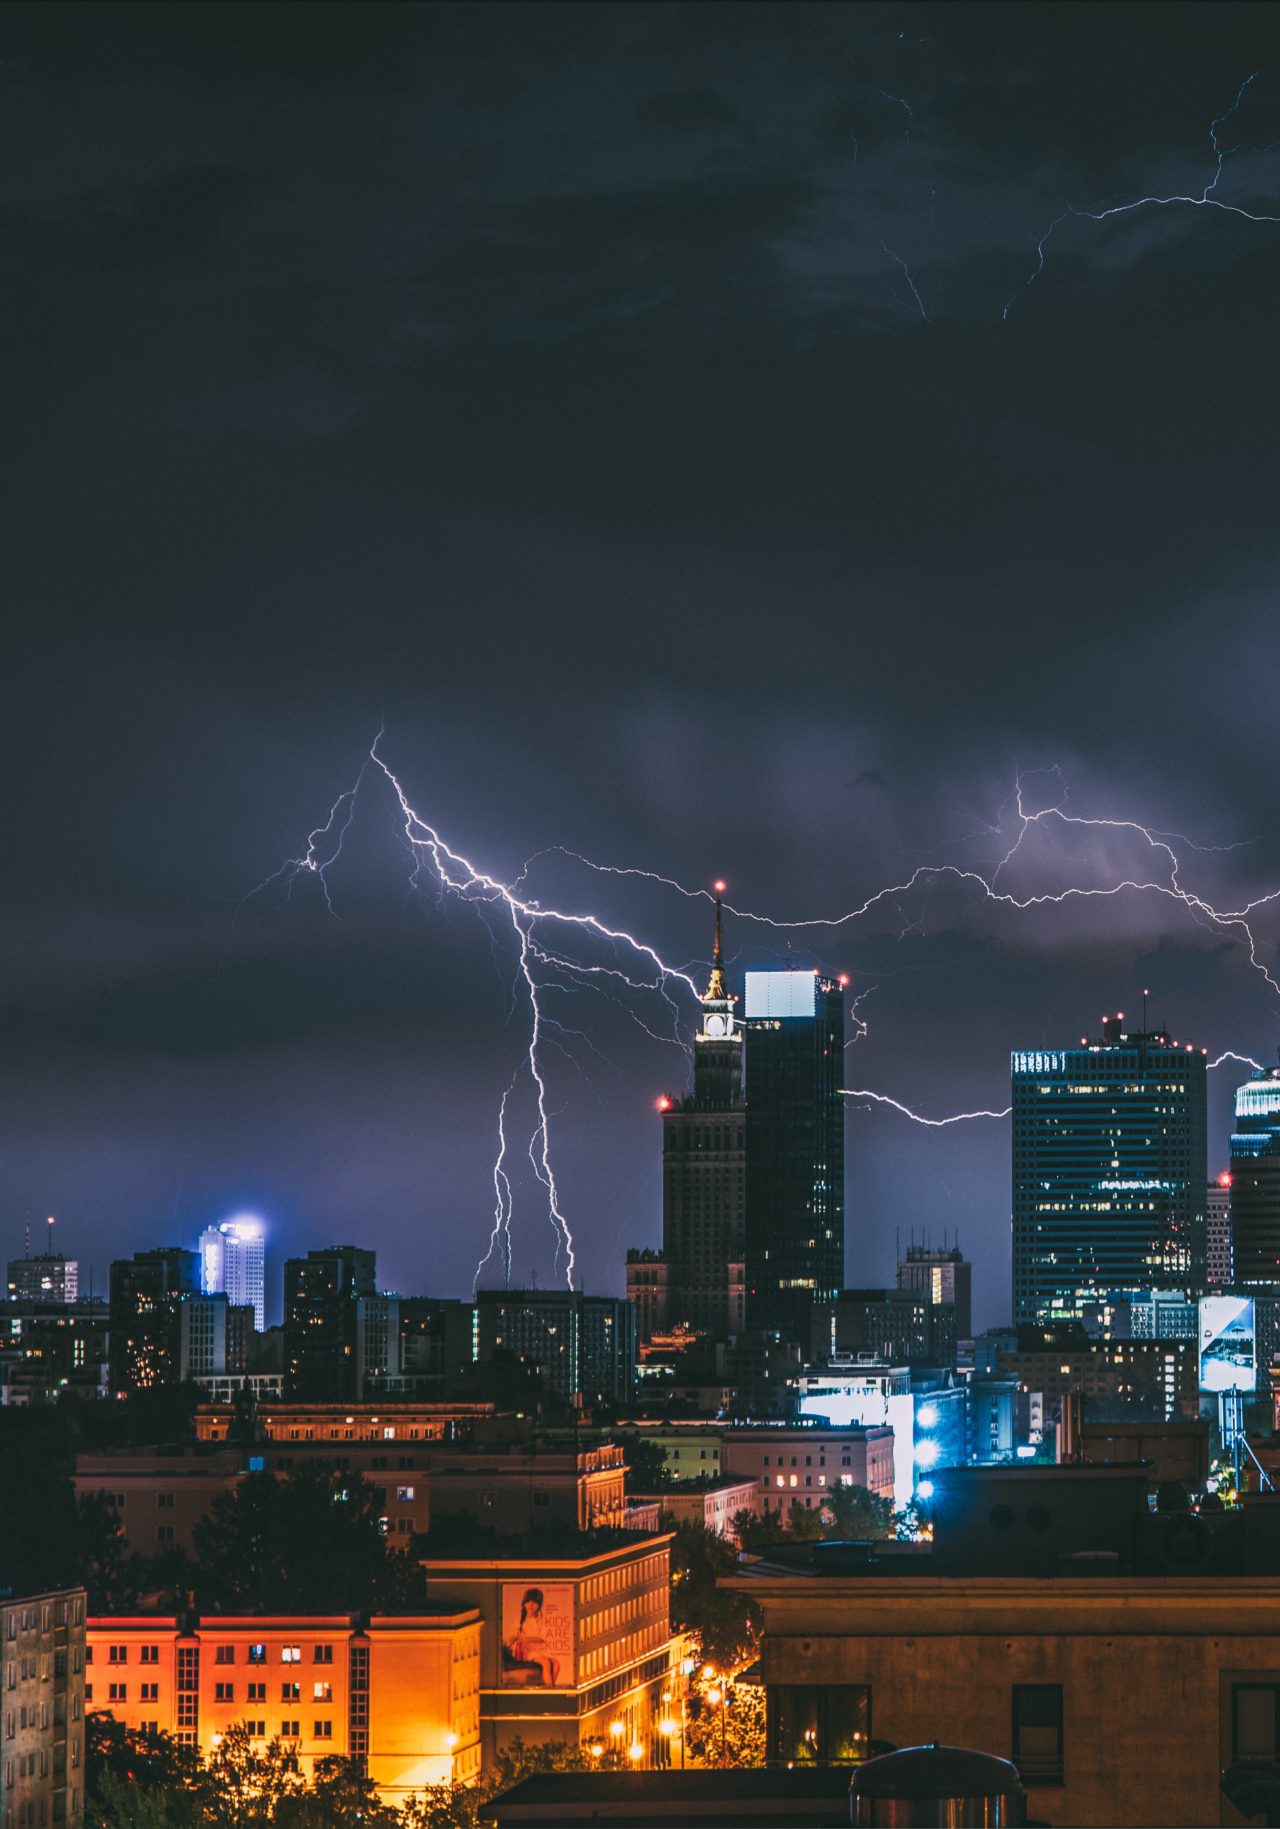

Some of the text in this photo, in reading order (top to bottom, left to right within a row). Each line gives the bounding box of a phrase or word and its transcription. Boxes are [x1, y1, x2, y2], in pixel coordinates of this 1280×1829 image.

[545, 1616, 570, 1628] KIDS
[545, 1628, 570, 1639] ARE
[545, 1640, 570, 1652] KIDS
